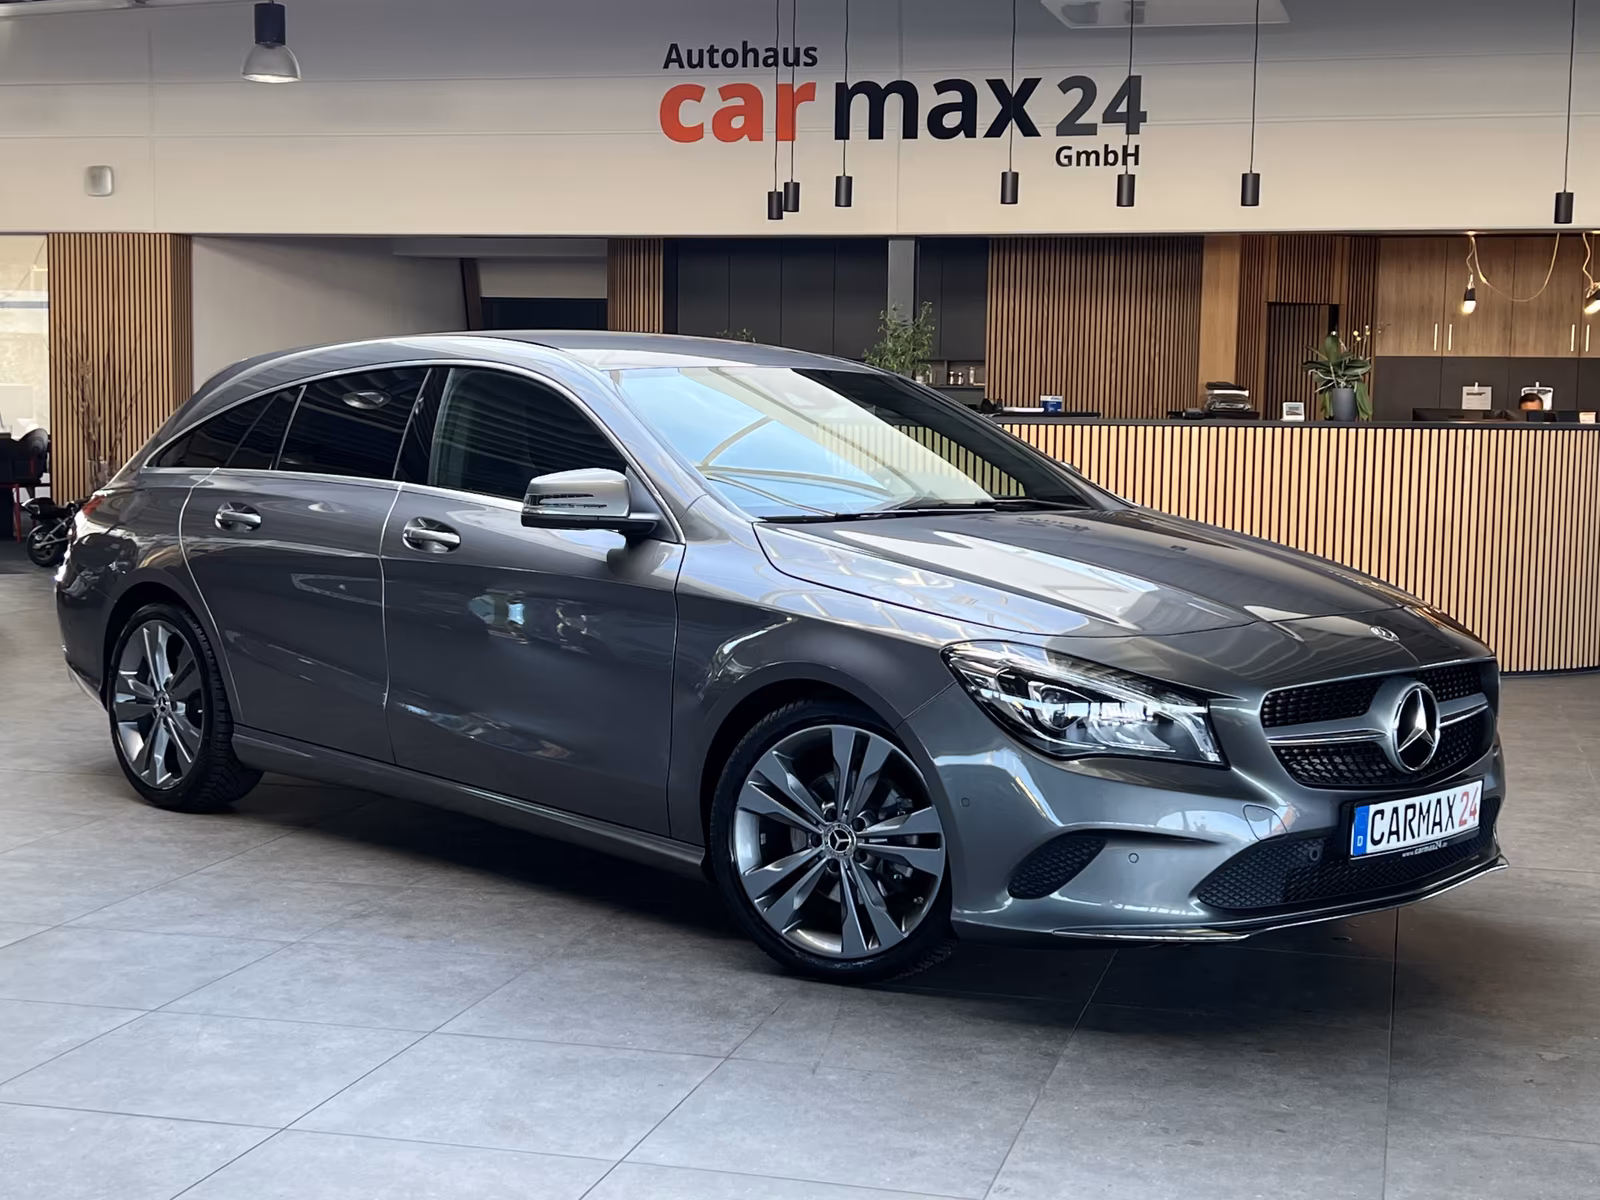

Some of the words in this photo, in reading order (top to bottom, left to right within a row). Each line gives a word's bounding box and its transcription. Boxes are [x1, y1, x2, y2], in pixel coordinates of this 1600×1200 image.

[663, 41, 818, 69] Autohaus
[1055, 74, 1148, 136] 24
[1055, 143, 1141, 167] GmbH
[1370, 794, 1456, 846] CARMAX
[1458, 787, 1479, 827] 24
[1357, 836, 1363, 846] D
